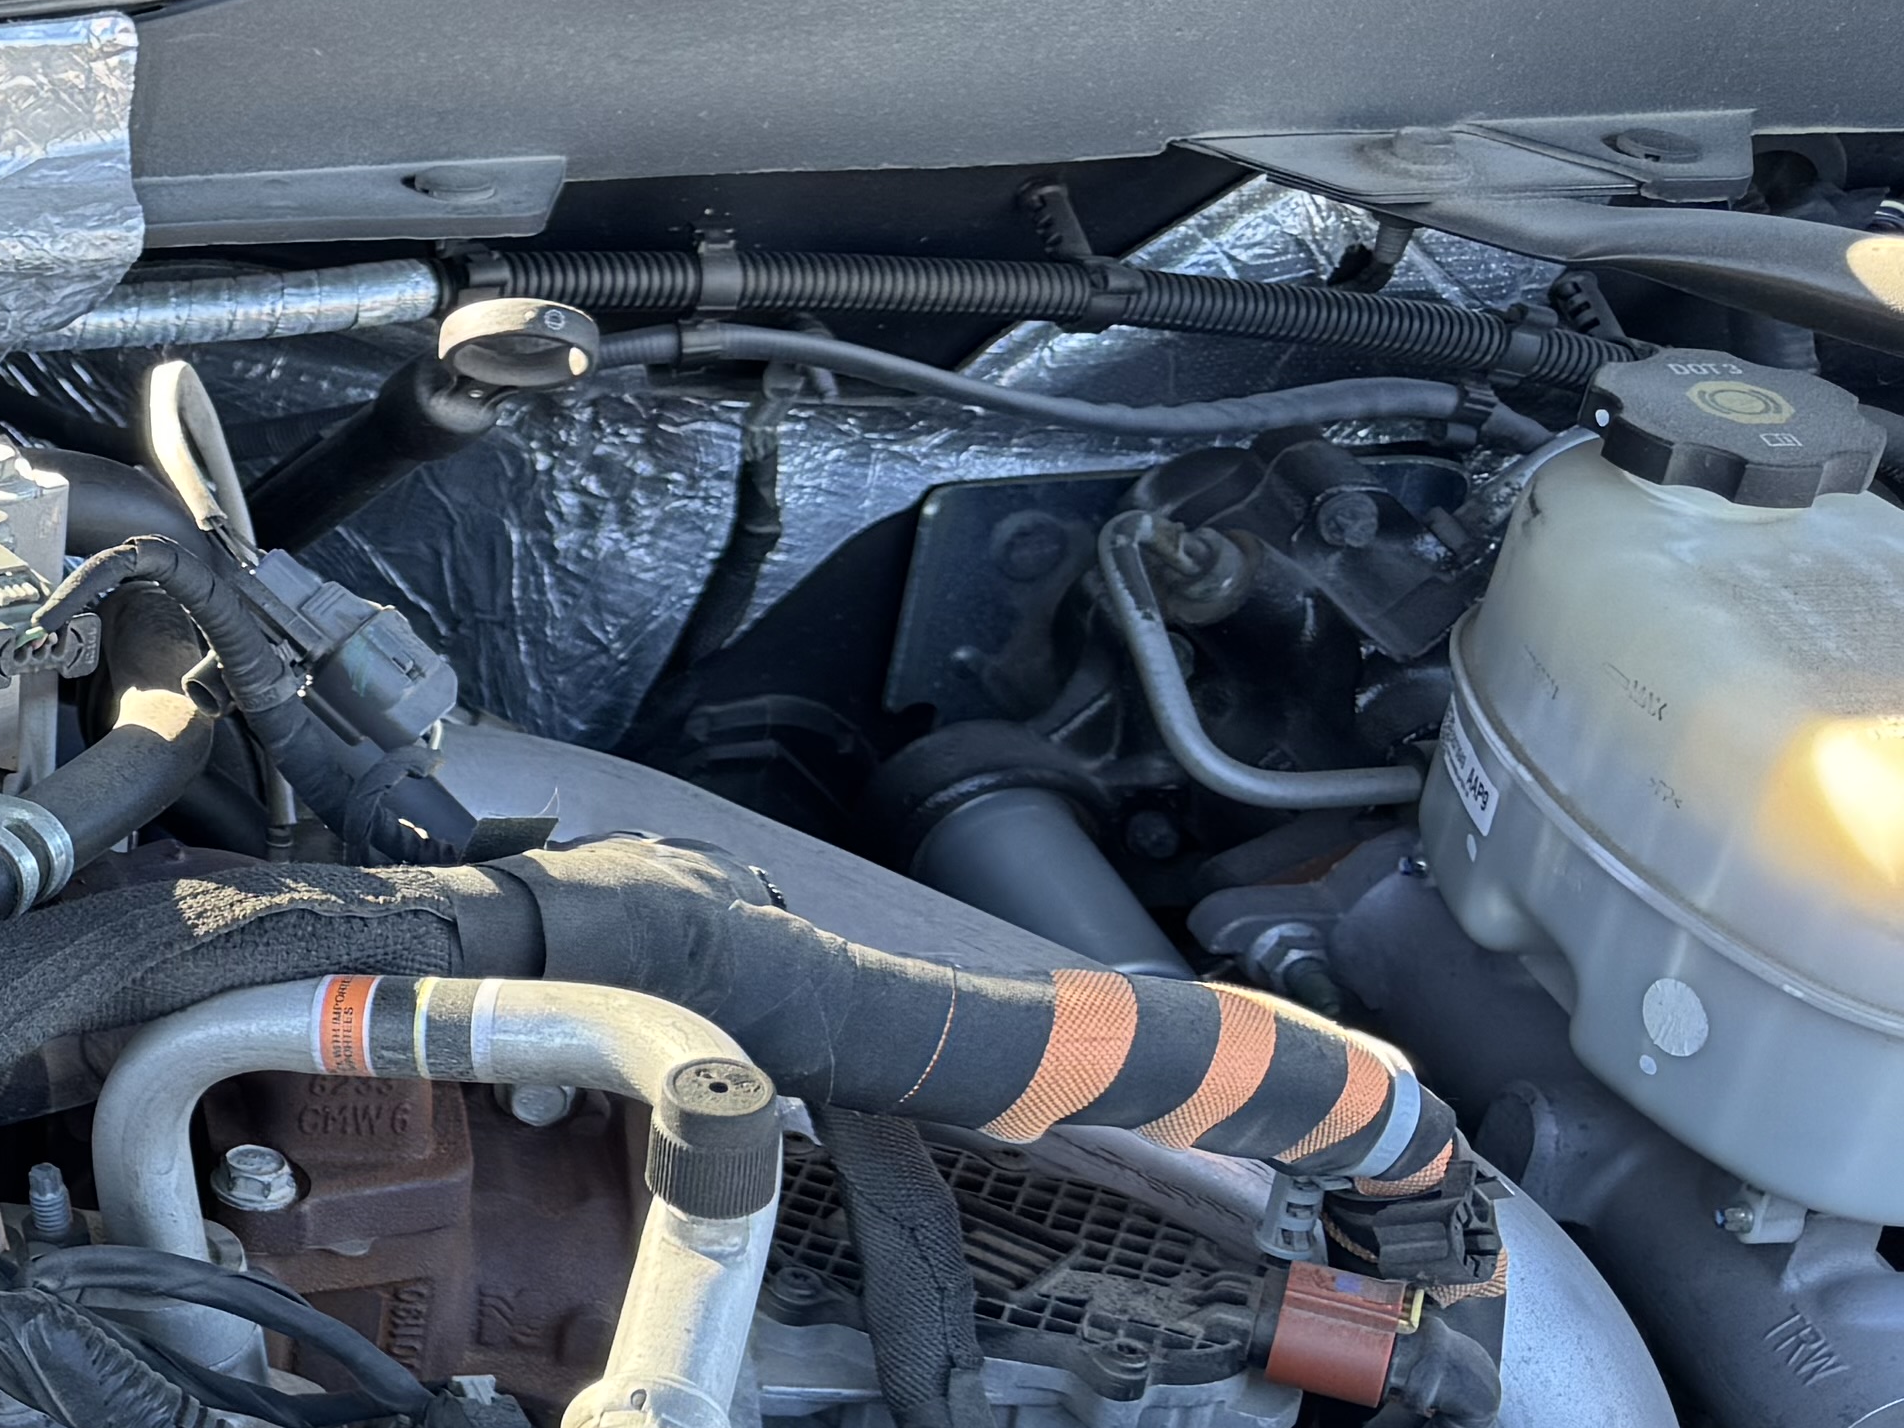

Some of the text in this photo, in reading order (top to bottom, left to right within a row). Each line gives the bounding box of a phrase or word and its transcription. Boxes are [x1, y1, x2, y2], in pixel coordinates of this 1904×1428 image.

[1668, 363, 1743, 375] DOT 3
[1465, 767, 1489, 811] AAP9
[1763, 1304, 1851, 1388] TRW
